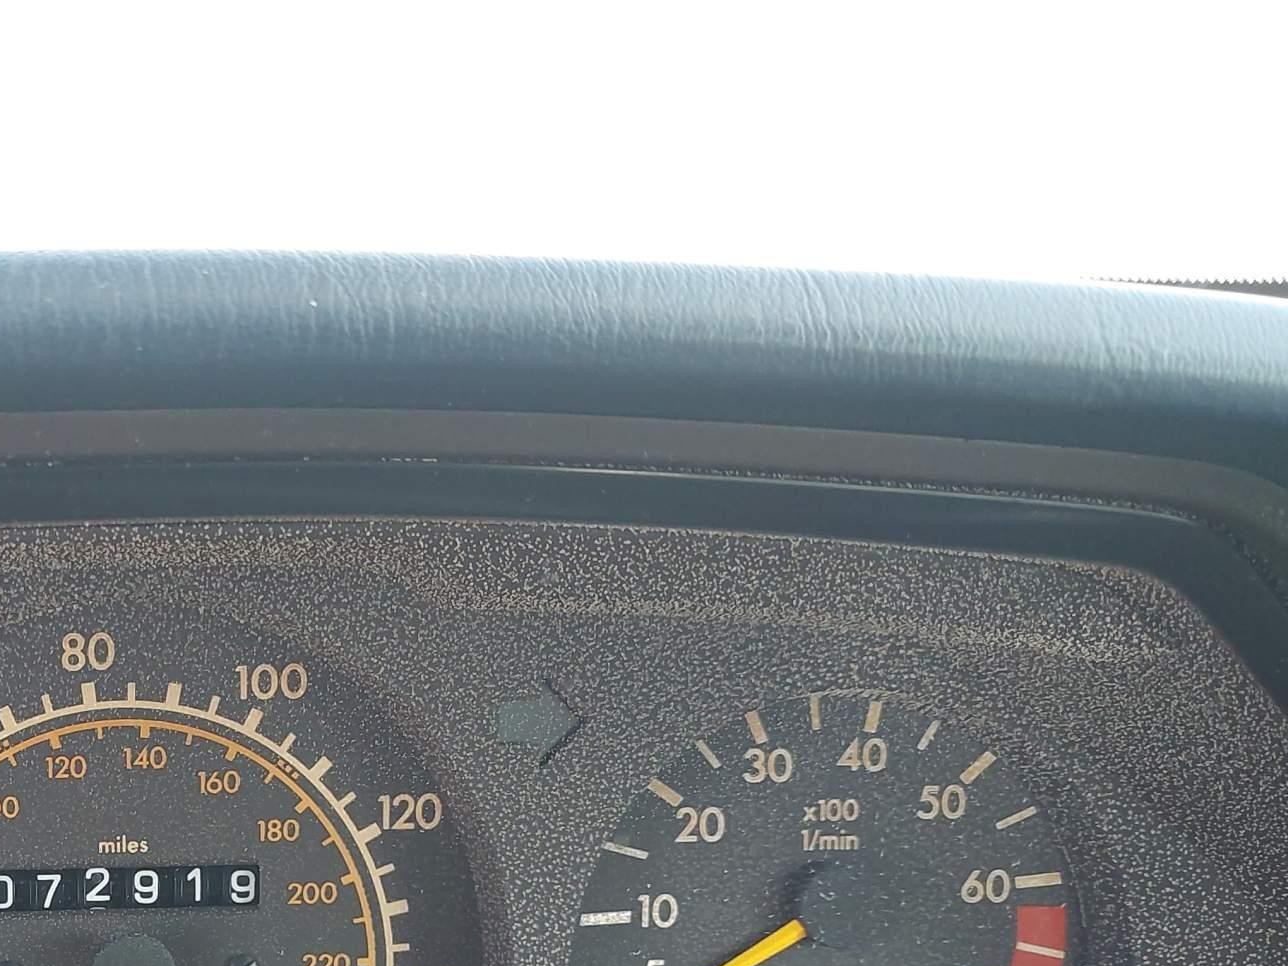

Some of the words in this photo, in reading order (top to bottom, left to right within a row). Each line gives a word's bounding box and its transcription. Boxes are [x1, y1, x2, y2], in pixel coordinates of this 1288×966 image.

[61, 632, 115, 671] 80
[235, 663, 308, 701] 100
[46, 756, 87, 779] 120
[123, 745, 168, 769] 140
[742, 748, 793, 783] 30
[837, 737, 888, 772] 40
[198, 770, 241, 794] 160
[377, 793, 443, 830] 120
[803, 799, 859, 821] x100
[917, 784, 967, 820] 50
[257, 819, 300, 842] 180
[674, 807, 726, 843] 20
[801, 829, 859, 851] 1/min
[98, 835, 149, 853] miles
[287, 881, 338, 905] 200
[960, 869, 1011, 904] 60
[638, 894, 679, 928] 10
